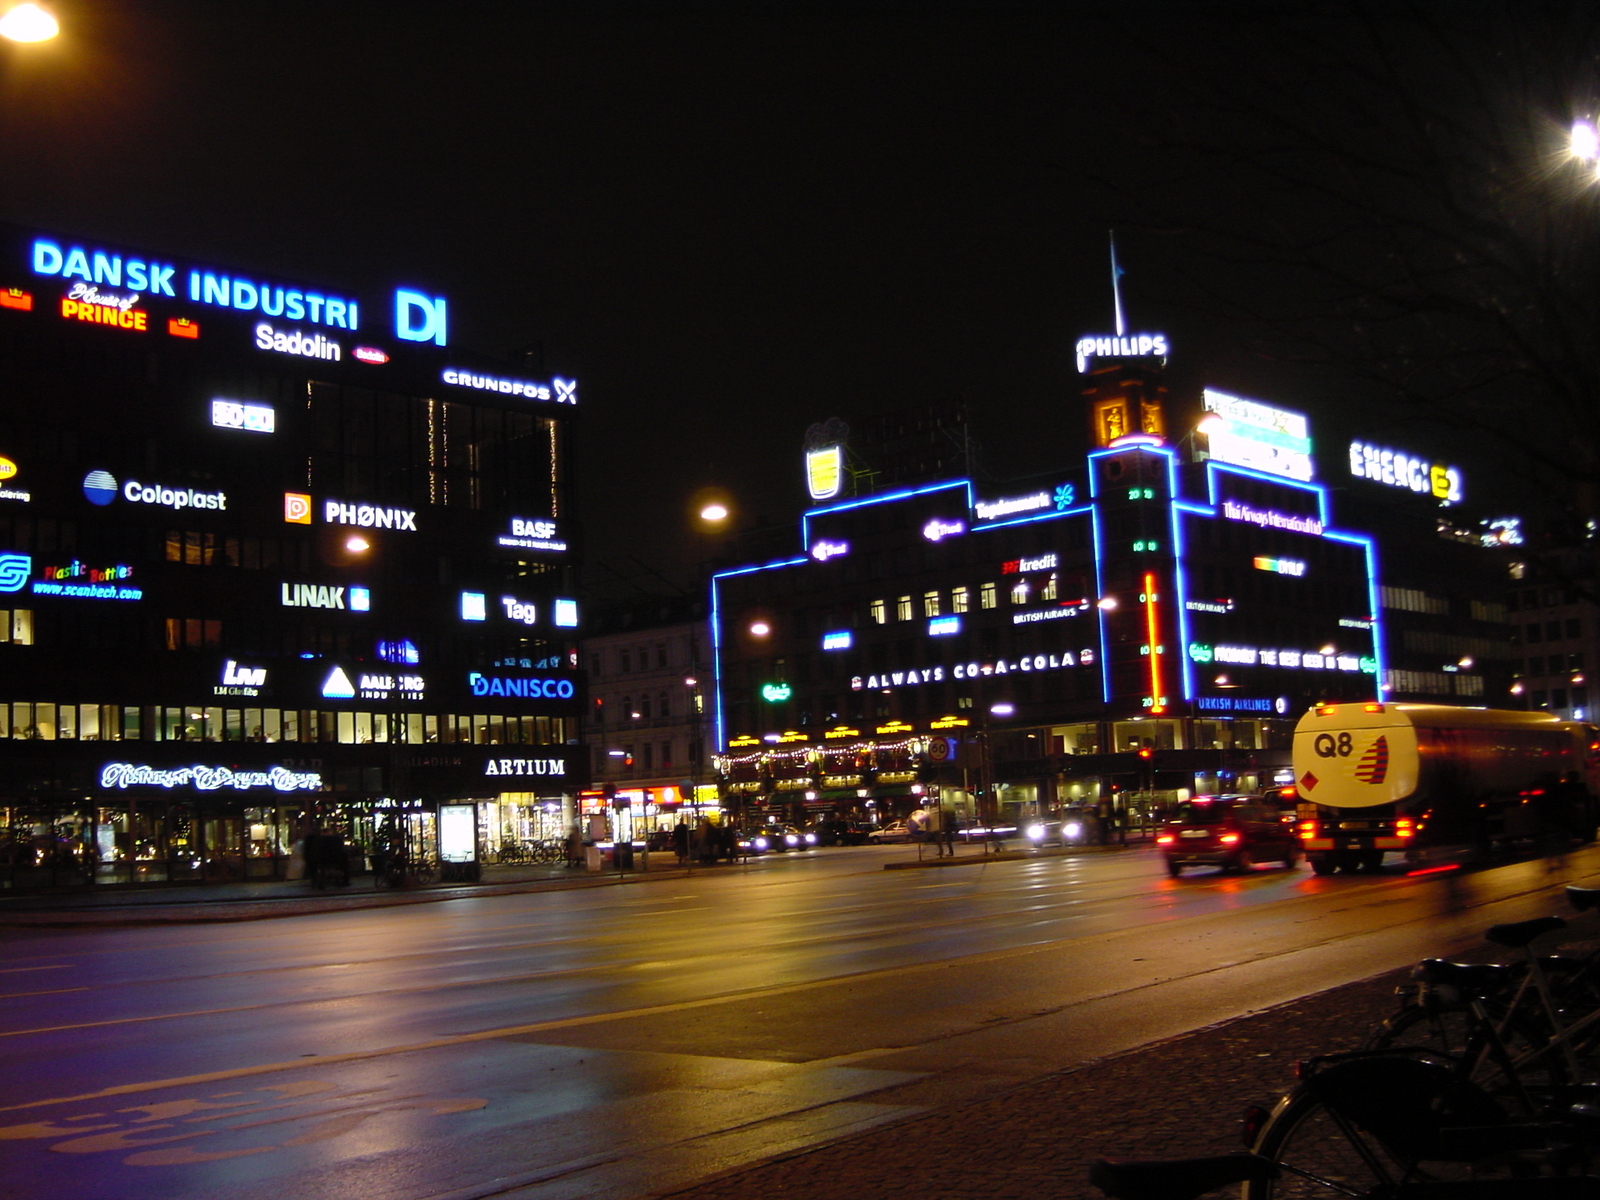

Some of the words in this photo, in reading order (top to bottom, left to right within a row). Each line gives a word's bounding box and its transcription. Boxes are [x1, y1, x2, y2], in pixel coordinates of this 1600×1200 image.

[33, 241, 176, 297] DANSK
[189, 268, 358, 331] INDUSTRI
[68, 283, 119, 307] House
[62, 299, 147, 331] PRINCE
[396, 289, 447, 347] DI
[255, 324, 341, 362] Sadolin
[1082, 336, 1167, 357] PHILIPS
[442, 370, 551, 401] GRUNDFOS
[124, 480, 226, 511] Coloplast
[326, 501, 417, 531] PHØNIX
[1222, 502, 1240, 519] Thai
[1241, 506, 1268, 527] Airways
[1268, 511, 1309, 533] International
[512, 519, 556, 539] BASF
[1132, 541, 1144, 551] 10
[44, 560, 87, 581] Plastic
[90, 565, 133, 583] Bottles
[33, 583, 143, 601] www.scanbech.com
[282, 583, 345, 609] LINAK
[502, 598, 536, 625] Tag
[1013, 612, 1043, 624] BRITISH
[223, 660, 267, 686] LM
[360, 675, 425, 691] AALBRG
[867, 668, 942, 689] ALWAYS
[953, 652, 1074, 679] COA-COLA
[213, 686, 228, 695] LM
[472, 676, 574, 699] DANISCO
[1234, 699, 1272, 711] AIRLINES
[932, 743, 946, 755] 60
[1314, 731, 1353, 758] Q8
[484, 758, 566, 776] ARTIUM
